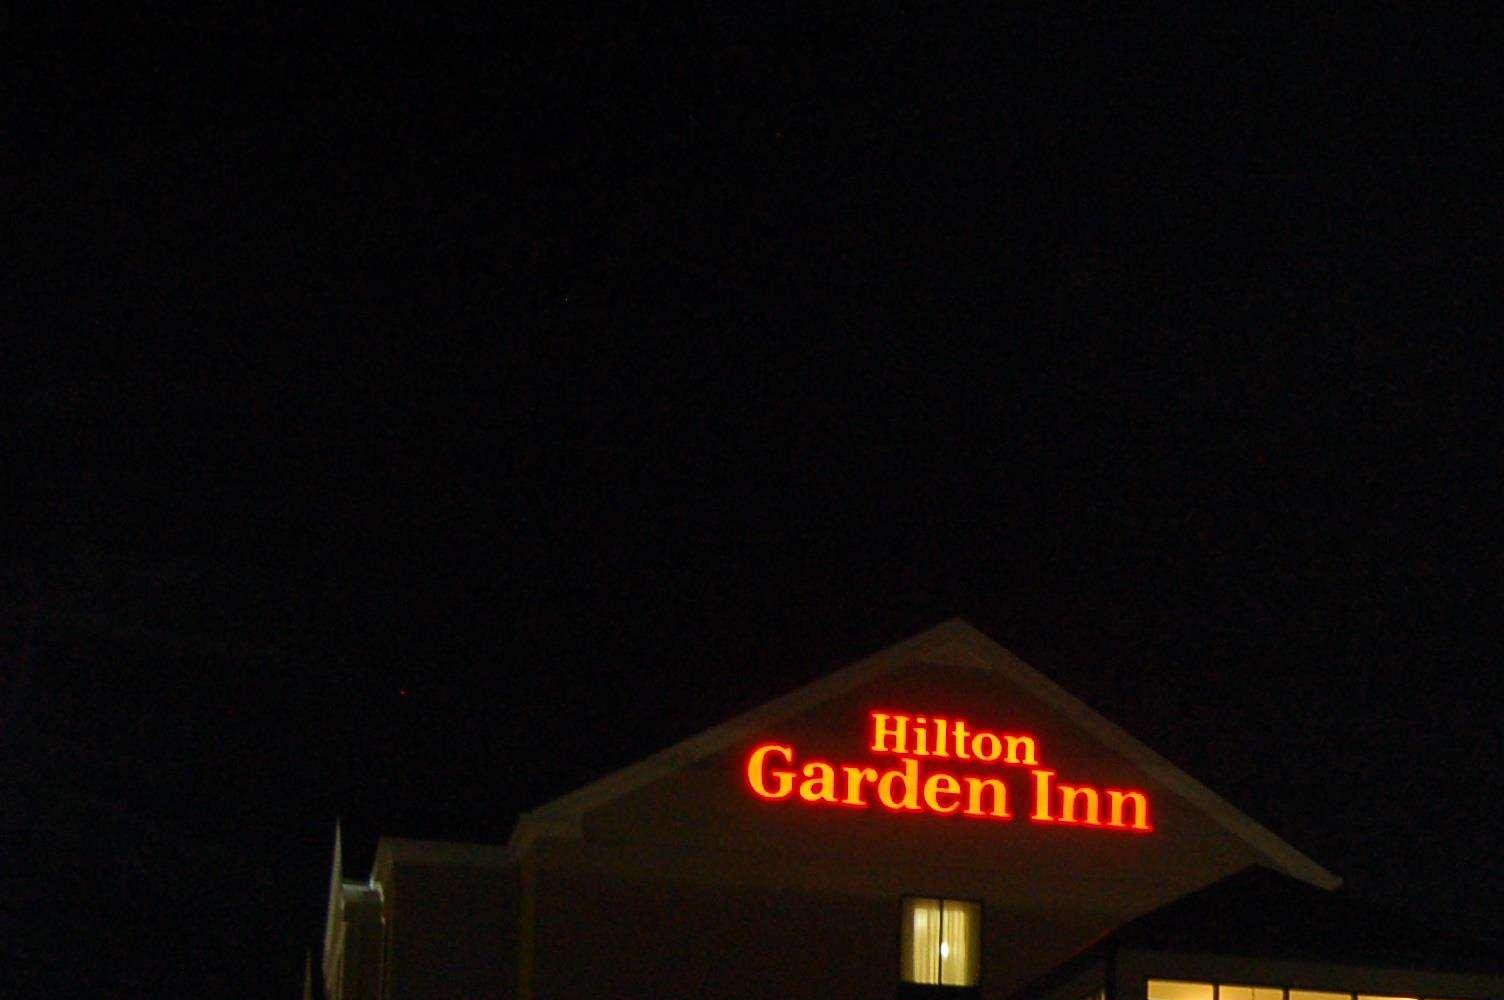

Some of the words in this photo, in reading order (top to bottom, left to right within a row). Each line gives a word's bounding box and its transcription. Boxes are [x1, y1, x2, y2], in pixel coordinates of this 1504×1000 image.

[871, 713, 1039, 766] Hilton
[746, 744, 1013, 820] Garden
[1030, 769, 1153, 831] Inn
